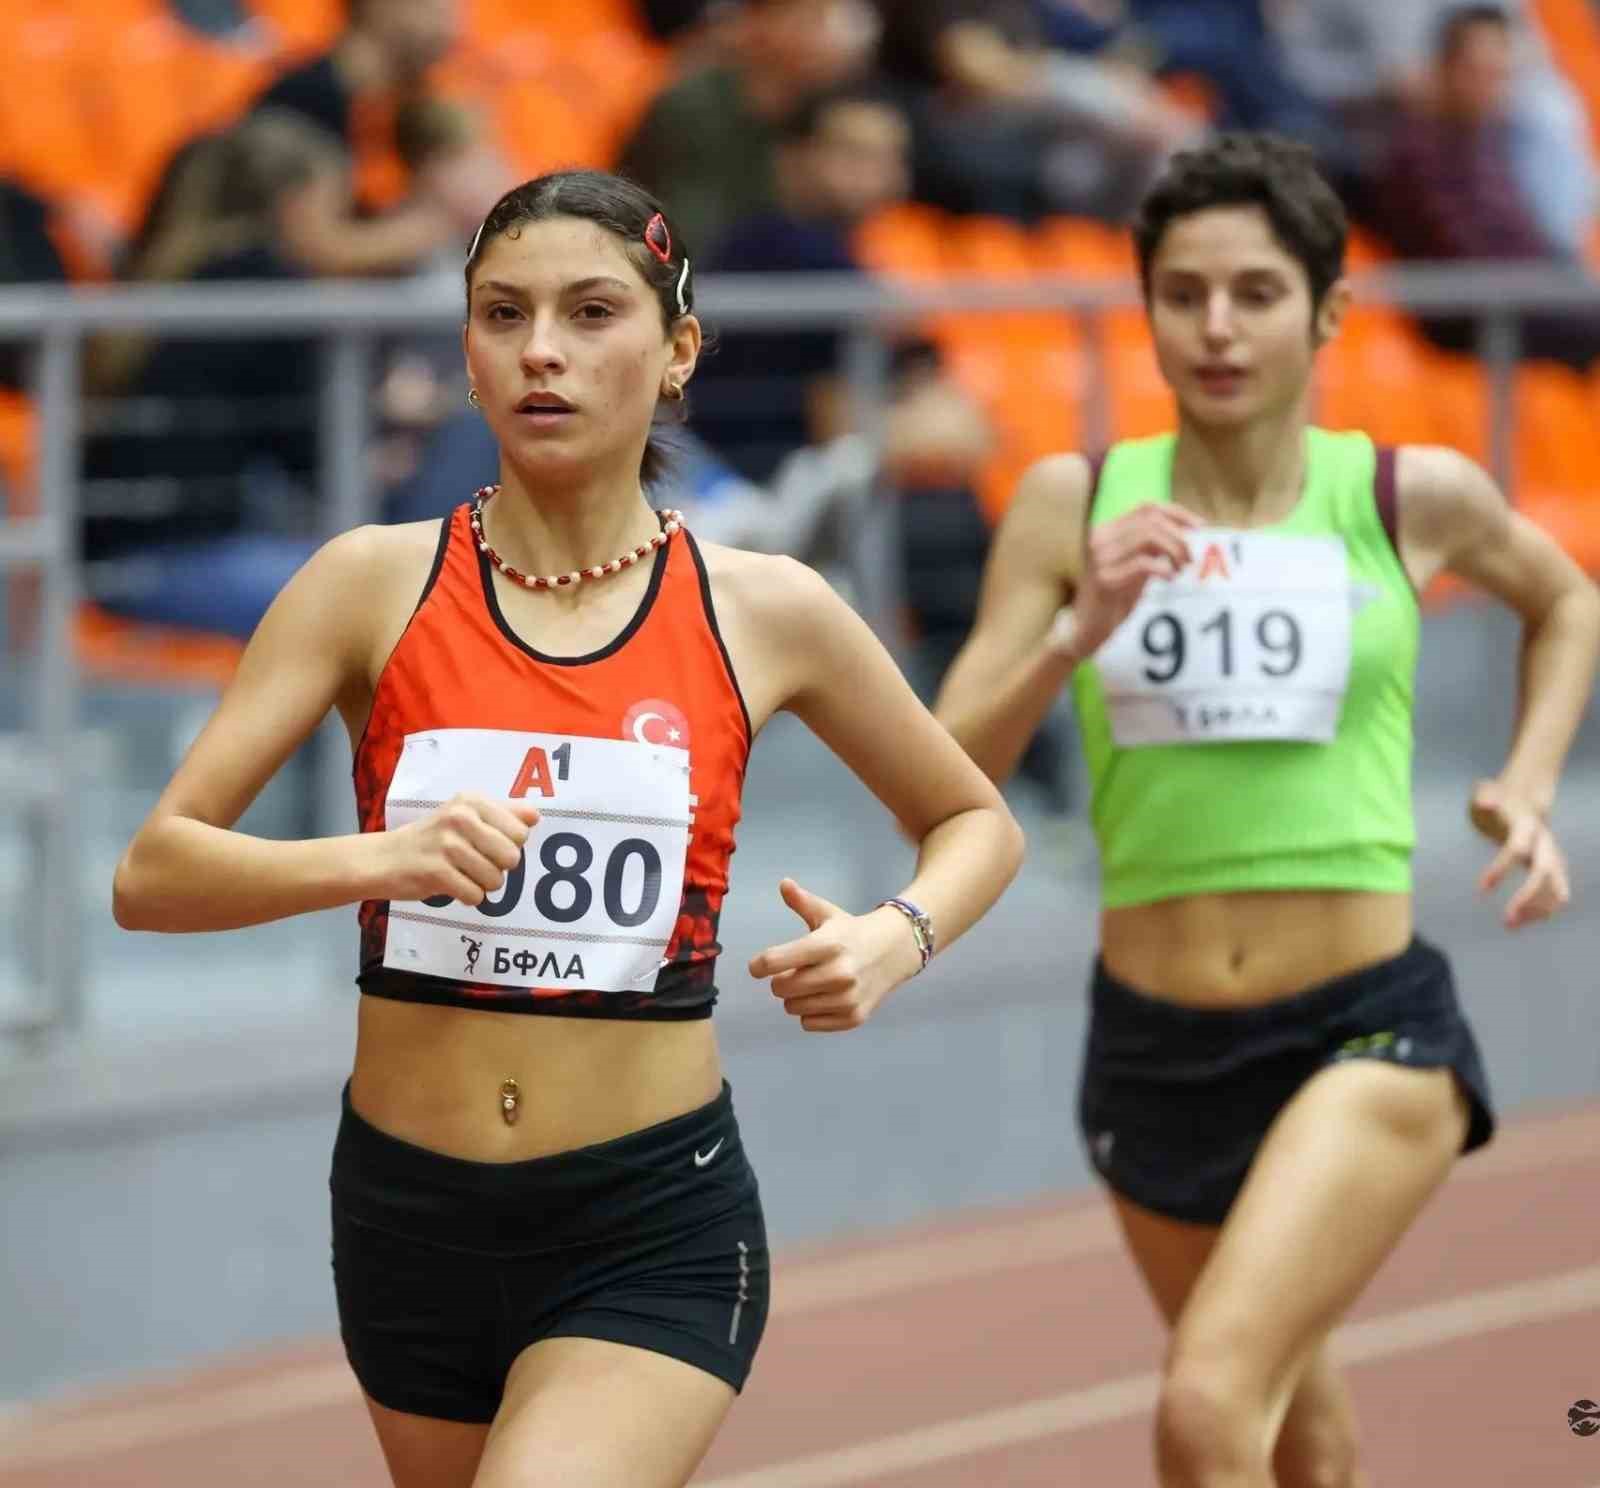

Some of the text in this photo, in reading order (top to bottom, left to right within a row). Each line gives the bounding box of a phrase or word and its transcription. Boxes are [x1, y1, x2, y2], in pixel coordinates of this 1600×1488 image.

[1141, 607, 1303, 684] 919
[508, 742, 572, 799] A1
[420, 832, 662, 927] 080
[493, 947, 585, 979] БФЛА
